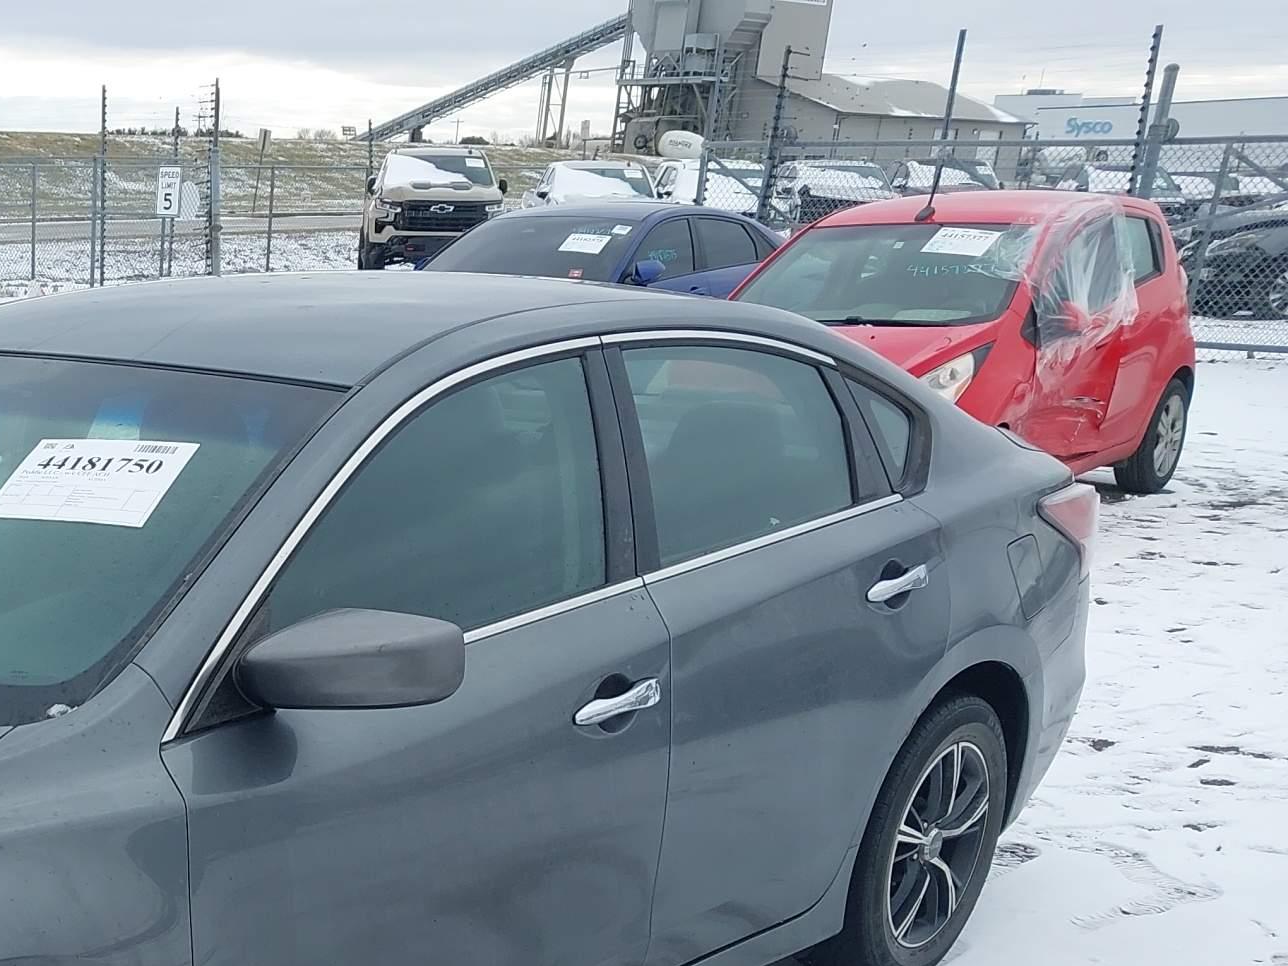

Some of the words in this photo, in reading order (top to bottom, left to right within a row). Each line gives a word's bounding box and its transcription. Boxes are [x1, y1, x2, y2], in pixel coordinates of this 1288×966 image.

[1064, 117, 1113, 138] Sysco
[160, 171, 180, 179] SPEED
[161, 182, 177, 190] LIMIT
[163, 192, 173, 211] 5
[37, 455, 164, 475] 44181750
